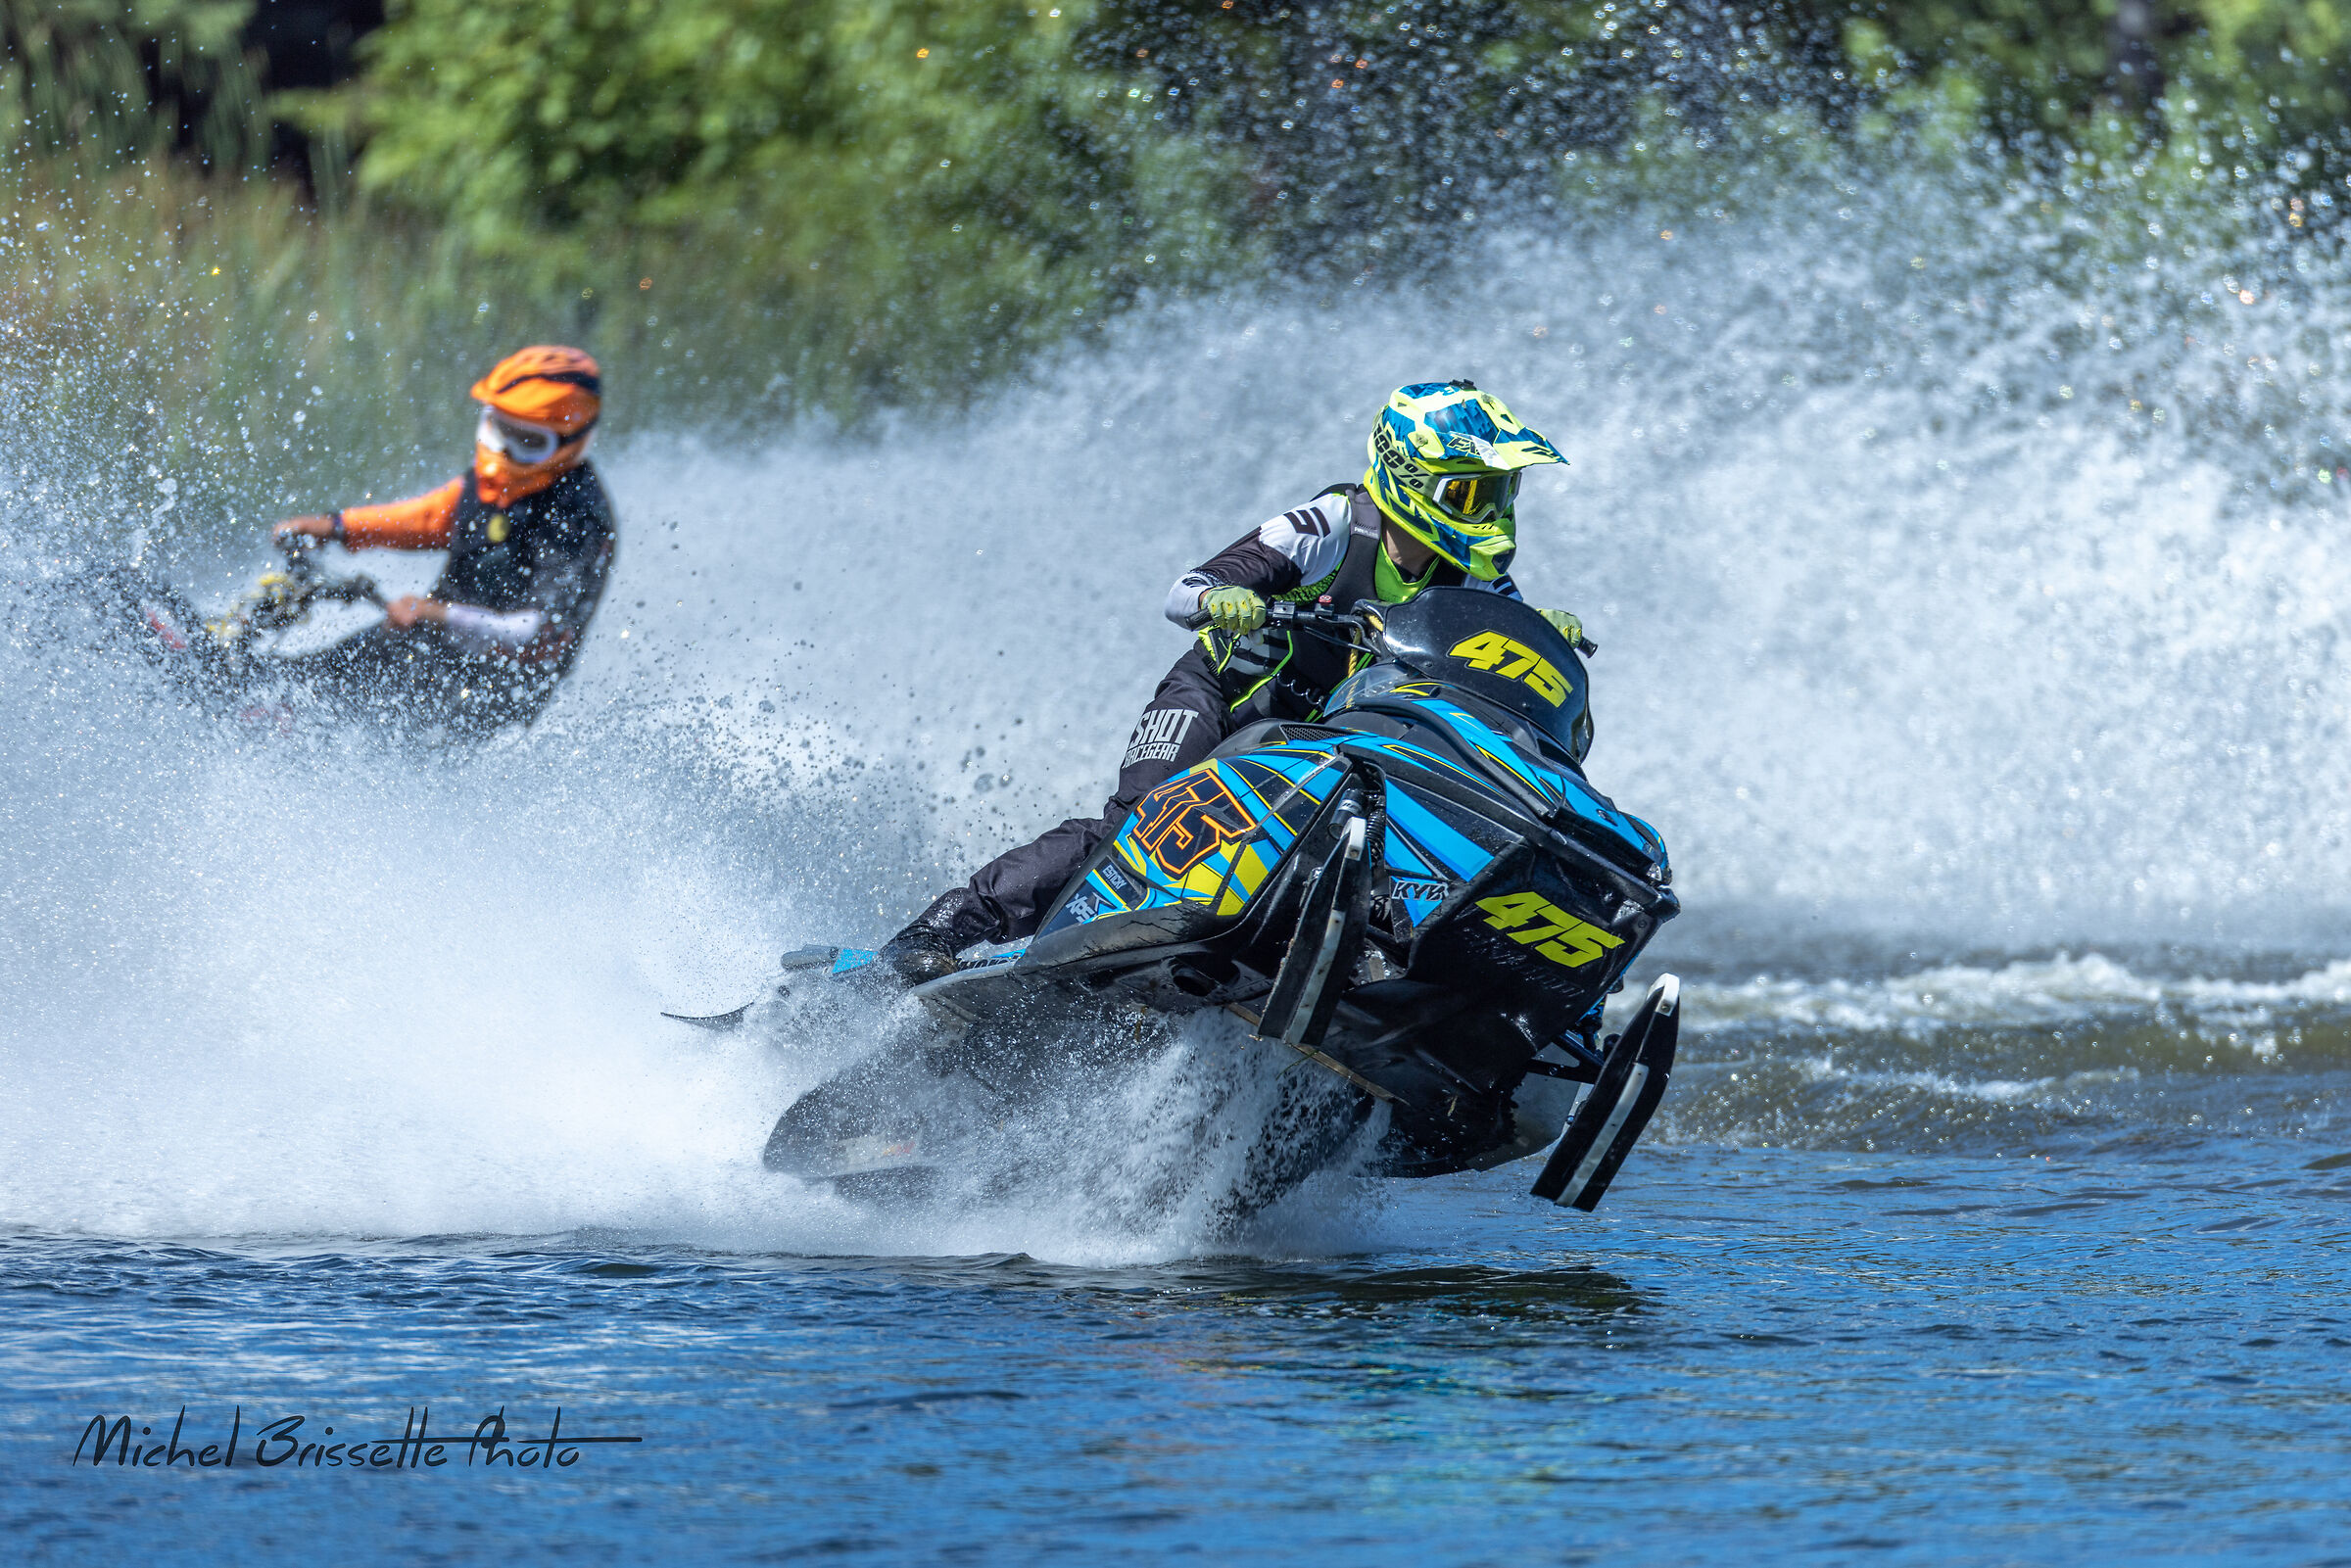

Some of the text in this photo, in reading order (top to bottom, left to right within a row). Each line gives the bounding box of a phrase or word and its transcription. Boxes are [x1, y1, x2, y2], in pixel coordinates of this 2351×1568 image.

[1449, 630, 1573, 708] 475
[1128, 708, 1199, 750] SHOT
[1391, 879, 1450, 902] KYB
[1474, 891, 1626, 968] 475
